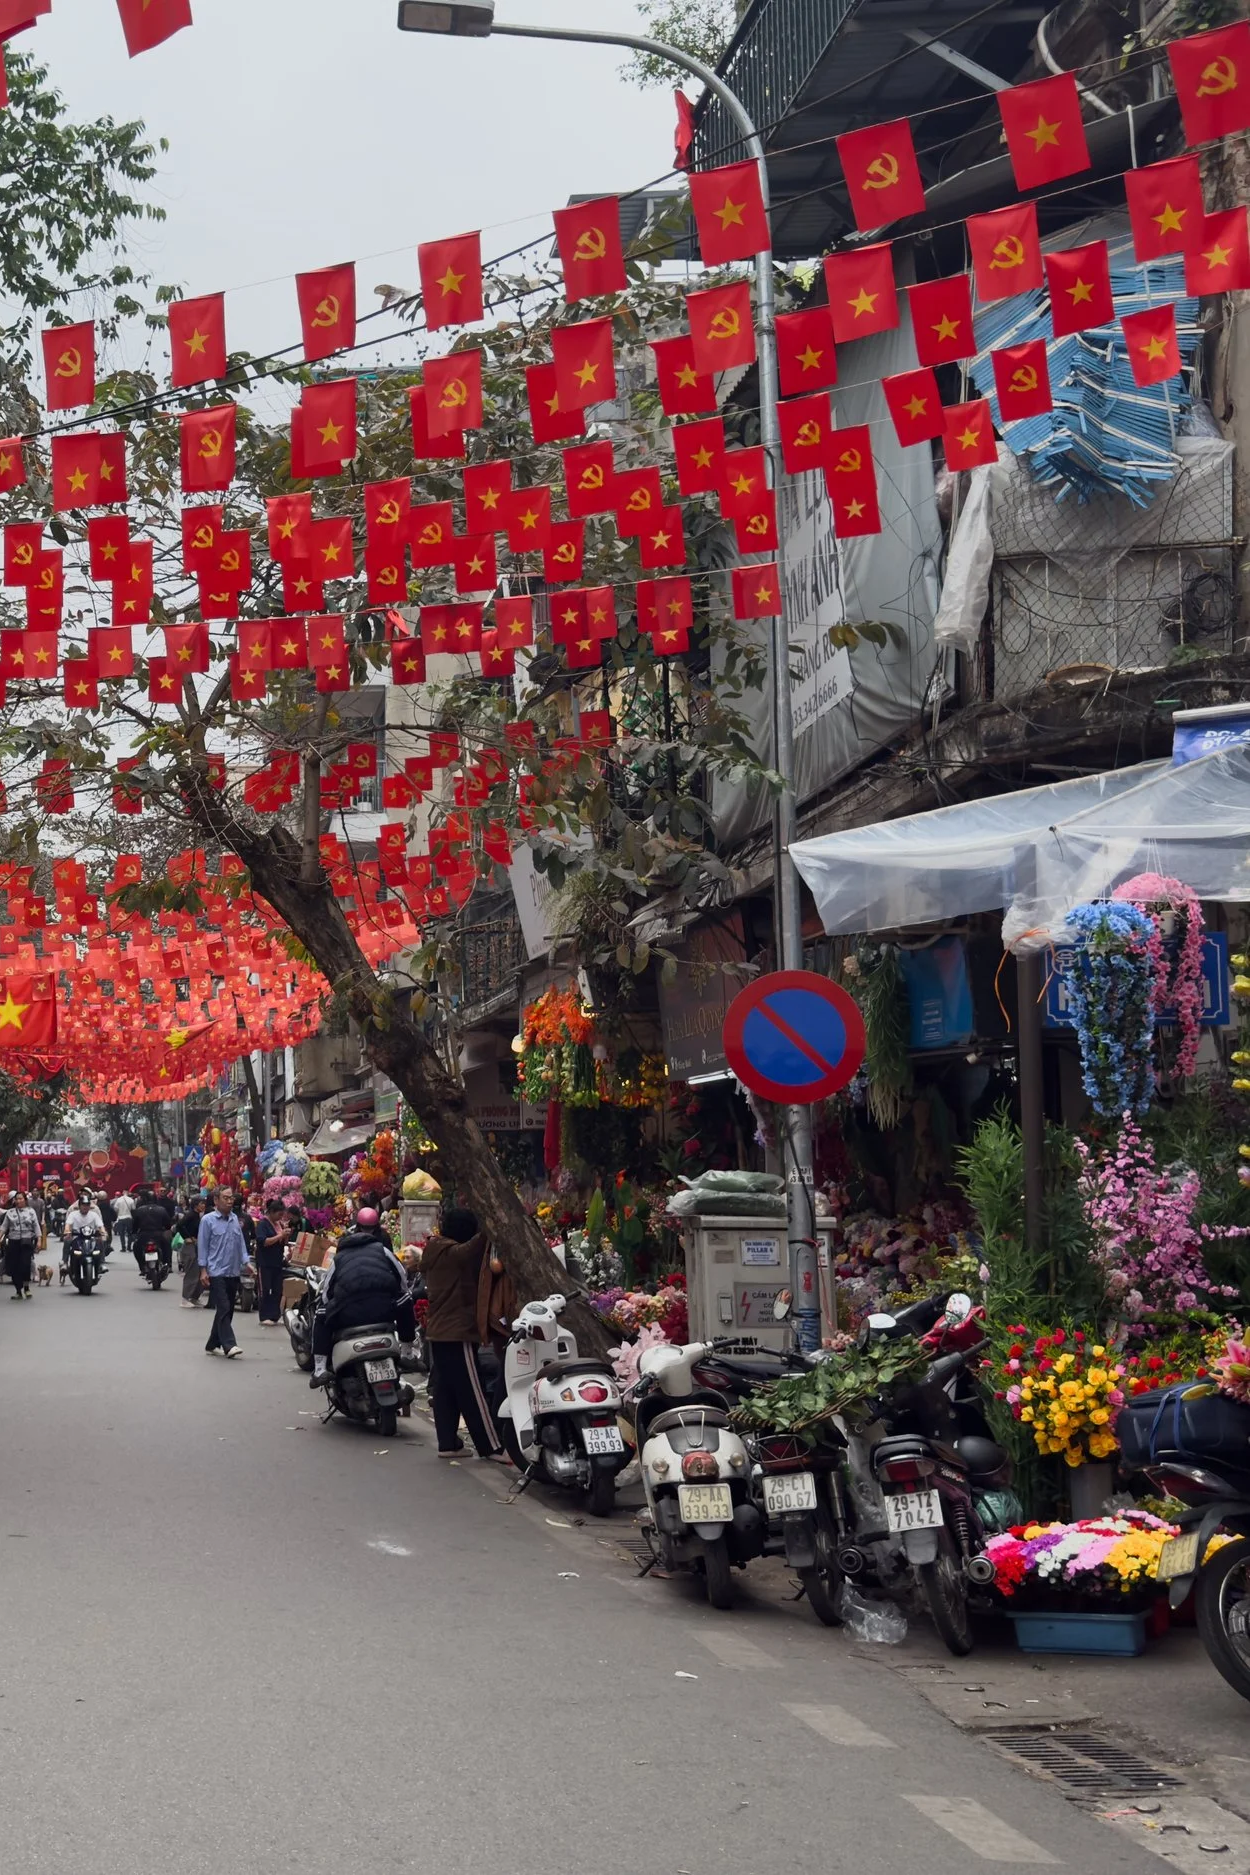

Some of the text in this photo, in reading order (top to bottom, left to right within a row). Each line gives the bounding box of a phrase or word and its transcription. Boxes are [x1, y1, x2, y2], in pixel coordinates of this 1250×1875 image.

[590, 1429, 615, 1440] 29-AC
[588, 1440, 622, 1453] 399.93
[687, 1486, 723, 1502] 29-AA
[768, 1491, 812, 1511] 090.67
[685, 1503, 729, 1520] 339.33
[894, 1508, 935, 1529] 7042
